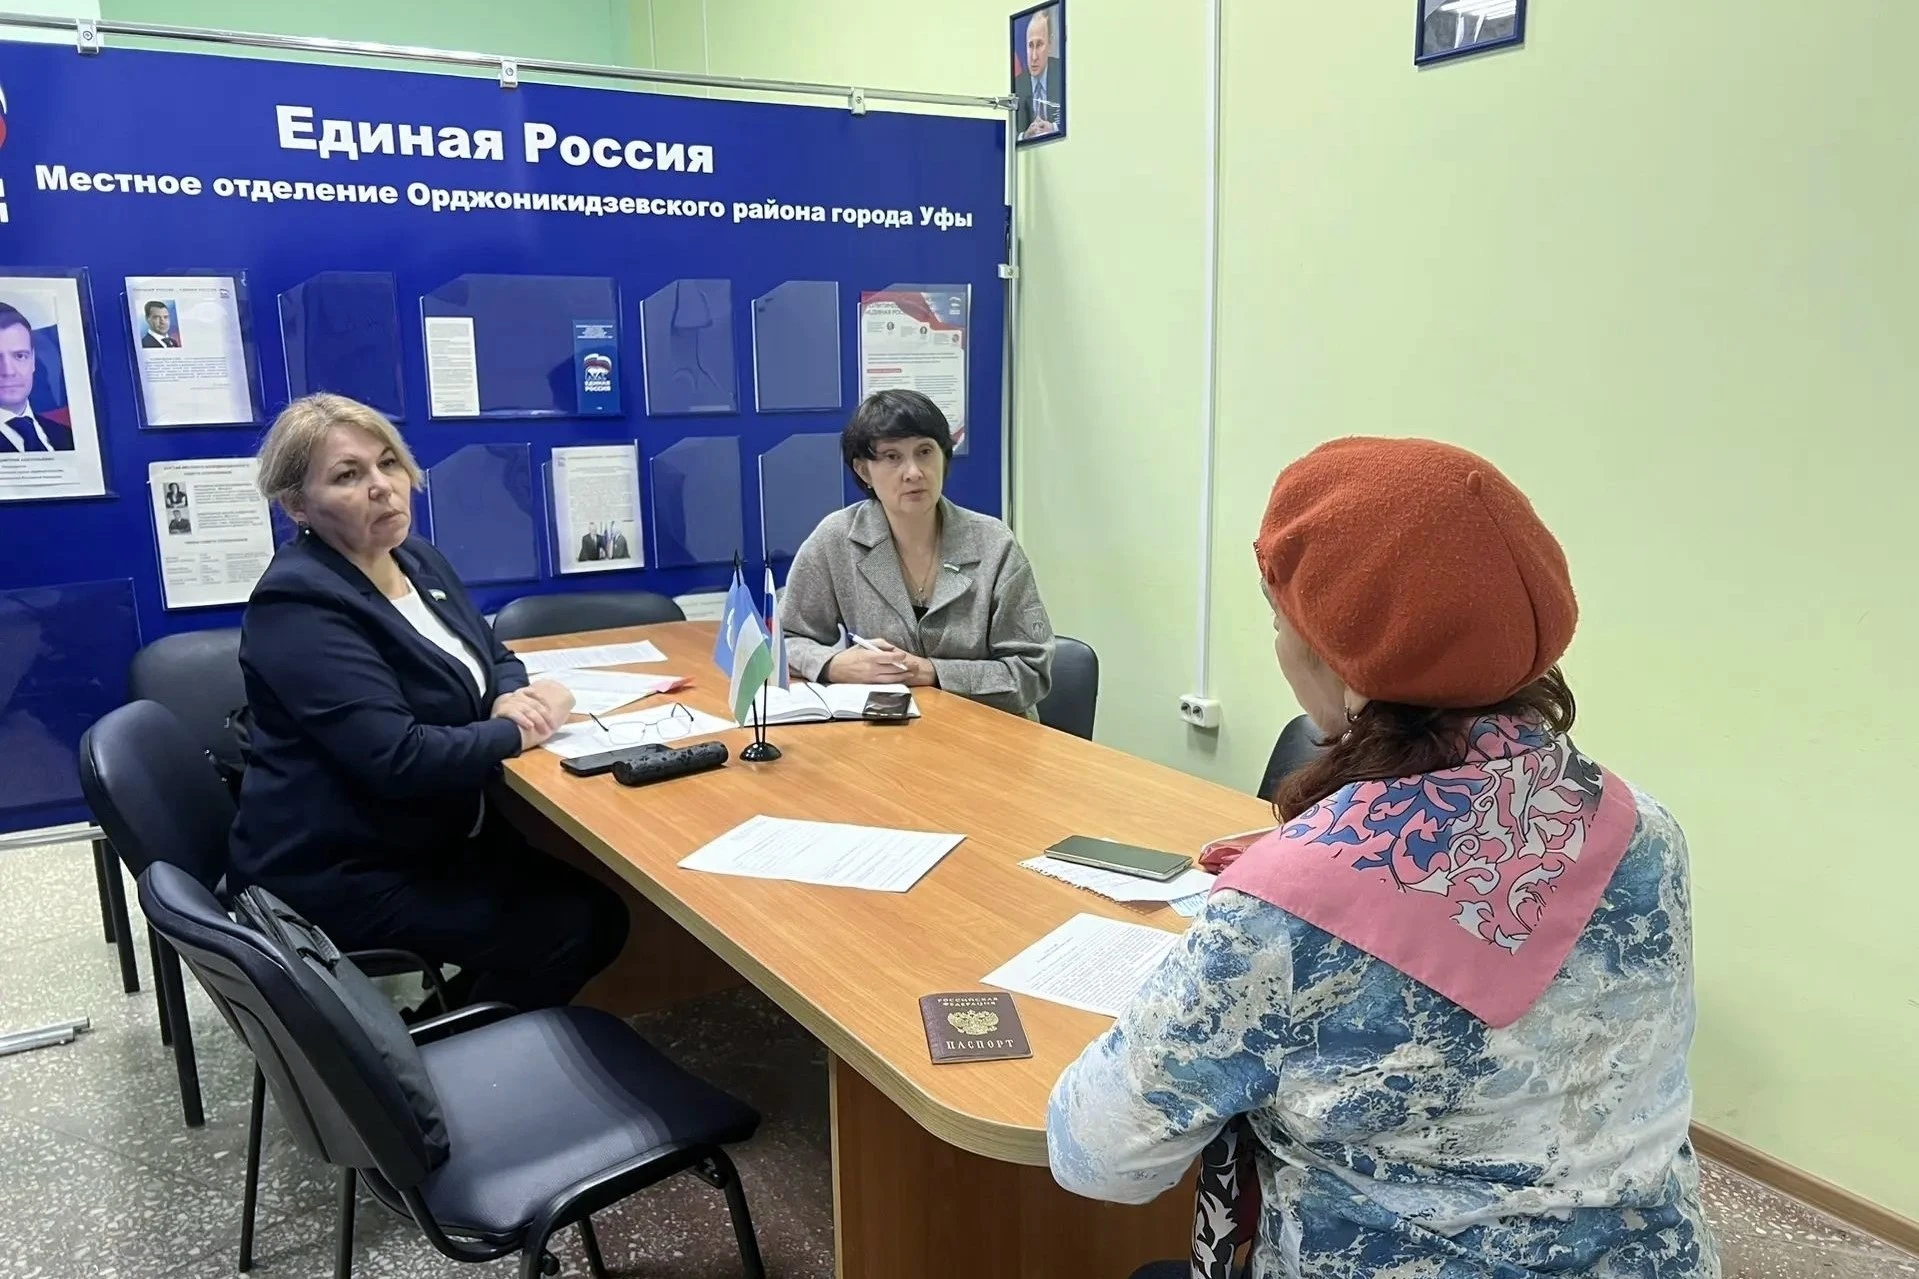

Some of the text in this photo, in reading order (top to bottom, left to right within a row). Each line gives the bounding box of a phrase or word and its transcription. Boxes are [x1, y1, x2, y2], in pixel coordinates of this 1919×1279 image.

[275, 104, 714, 174] Единая Россия
[34, 164, 974, 231] Местное отделение Орджоникидзевского района города Уфы
[946, 1039, 1015, 1050] ПАСПОРТ
